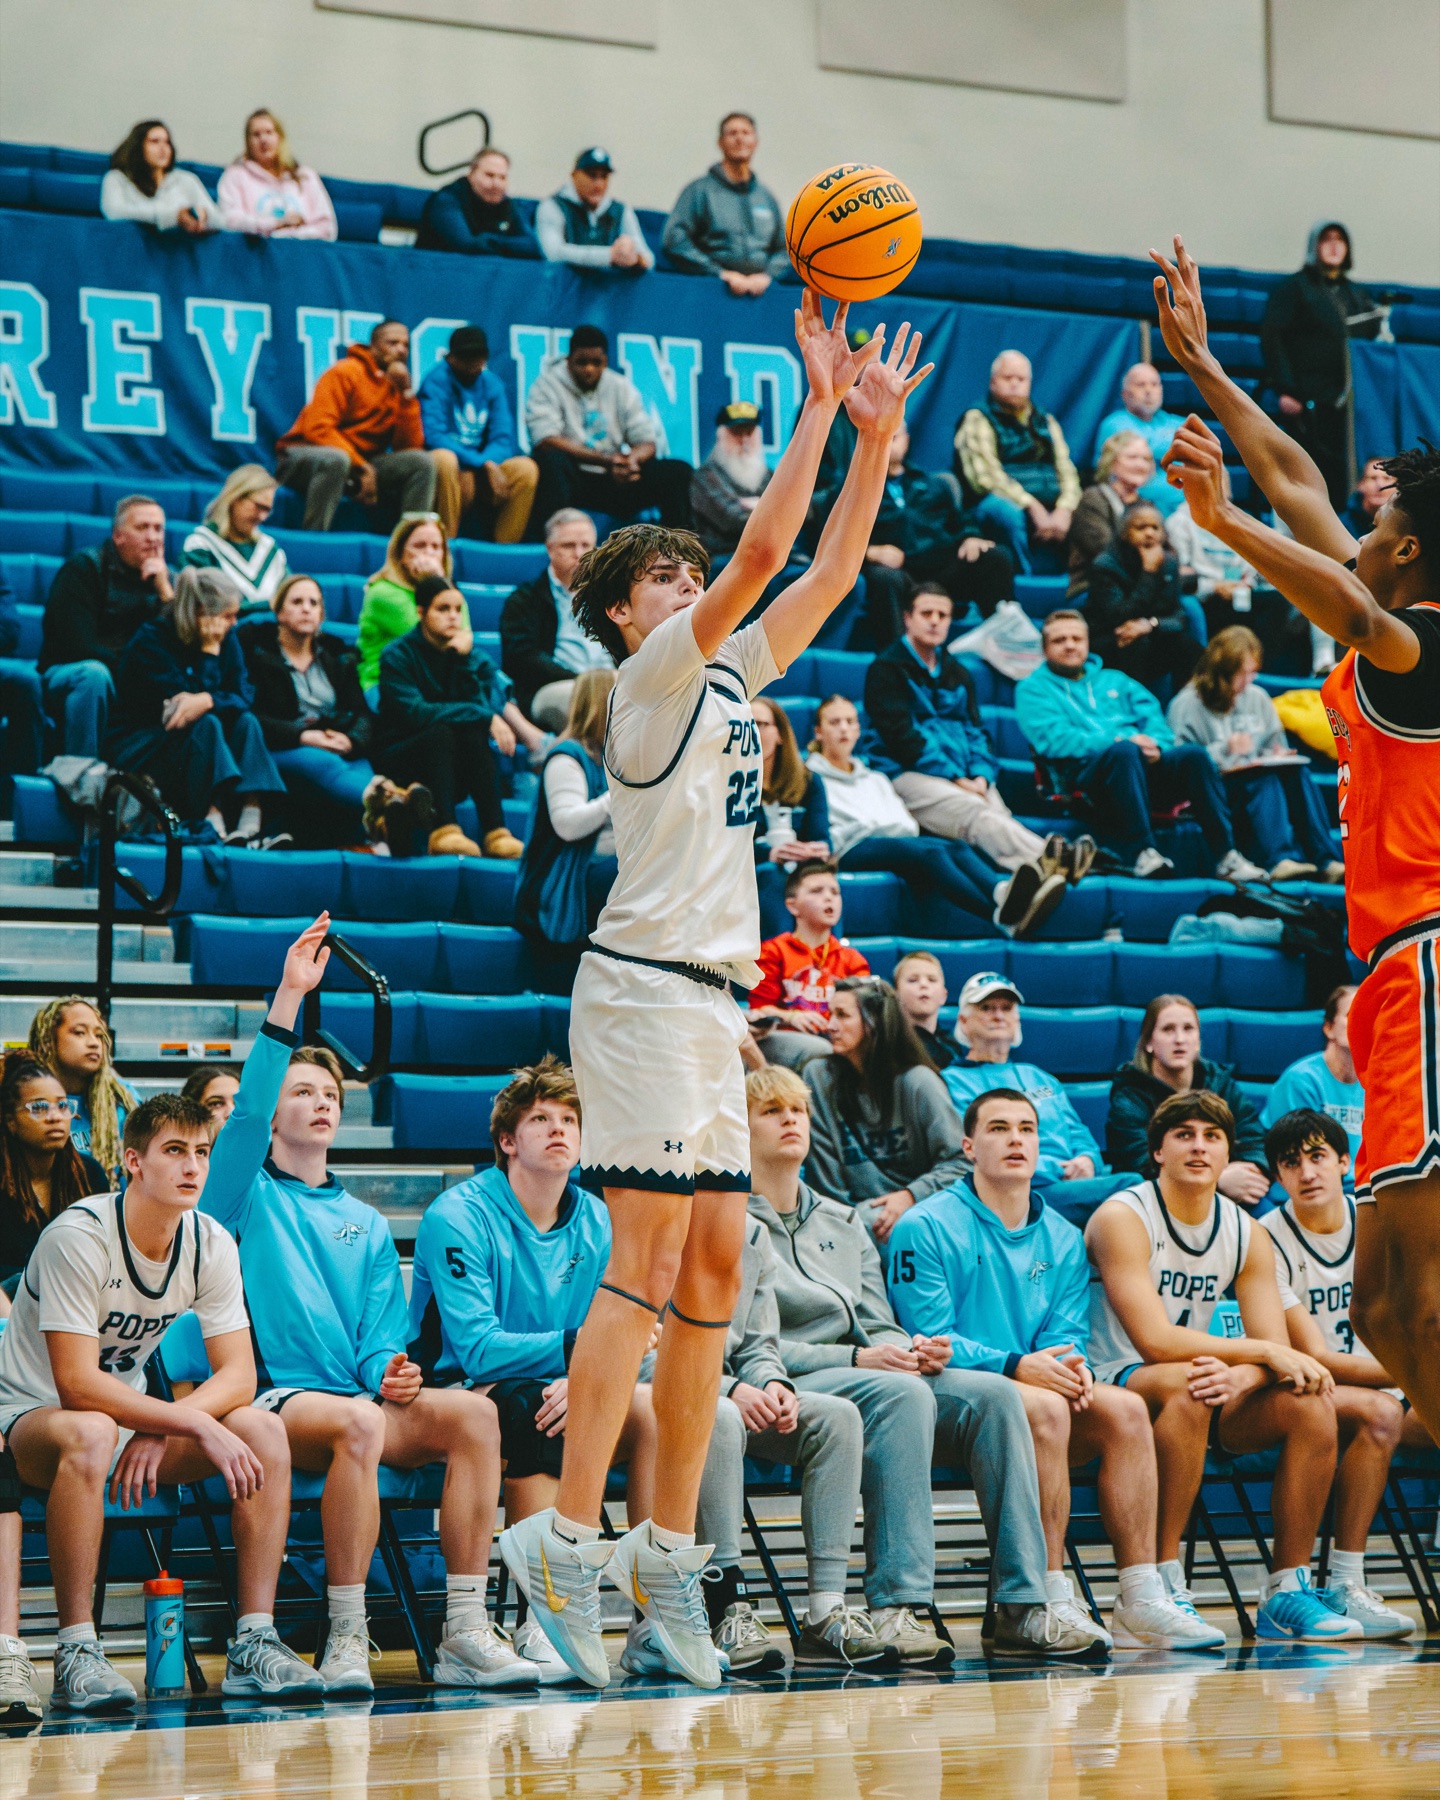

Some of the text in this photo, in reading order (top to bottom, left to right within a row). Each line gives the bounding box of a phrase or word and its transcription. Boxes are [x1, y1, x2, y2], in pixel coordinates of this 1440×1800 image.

[827, 183, 910, 223] Wilson
[445, 1247, 468, 1280] 5
[892, 1250, 916, 1284] 15
[1158, 1270, 1218, 1302] POPE
[155, 1611, 180, 1638] G
